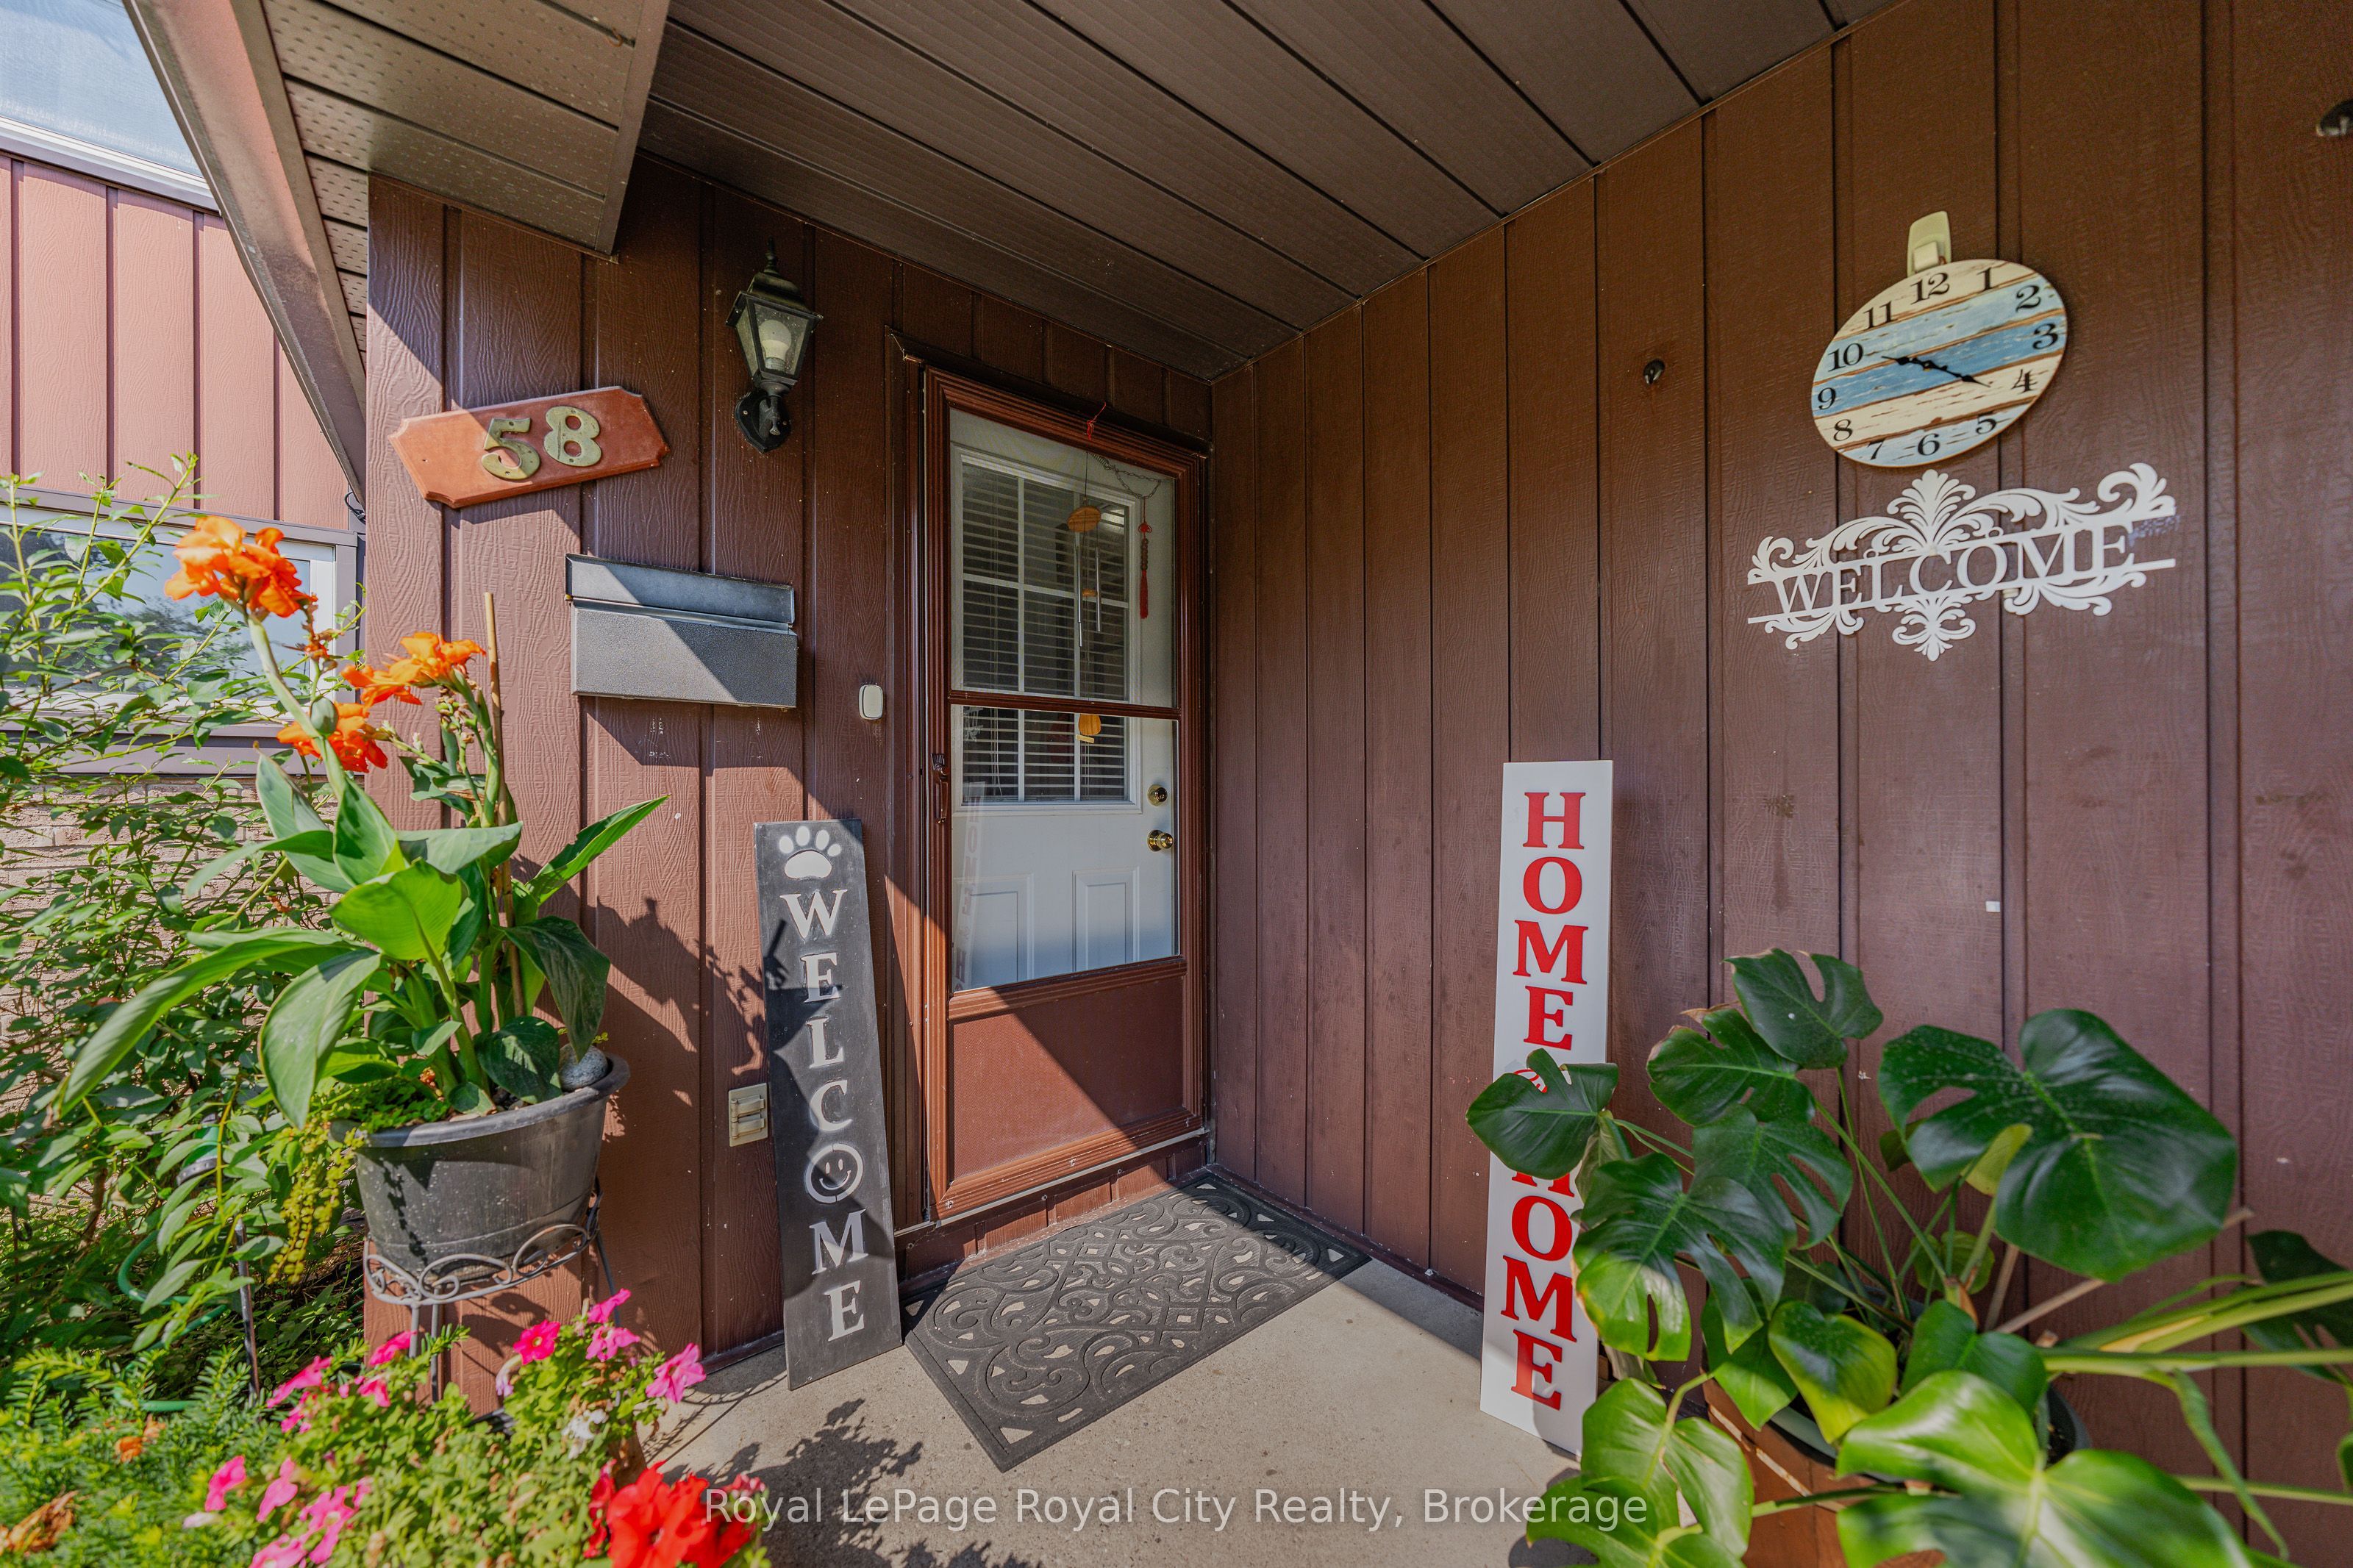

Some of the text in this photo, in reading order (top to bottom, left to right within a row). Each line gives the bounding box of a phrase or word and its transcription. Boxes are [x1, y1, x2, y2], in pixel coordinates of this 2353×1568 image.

[1910, 271, 1951, 305] 12
[1977, 267, 1998, 293] 1
[2015, 284, 2042, 314] 2
[1863, 302, 1899, 330] 11
[2032, 322, 2059, 351] 3
[1827, 342, 1864, 373] 10
[2010, 368, 2038, 393] 4
[1817, 387, 1837, 411] 9
[1833, 419, 1854, 442] 8
[1975, 412, 1998, 435] 5
[481, 405, 602, 481] 58
[1867, 439, 1887, 460] 7
[1917, 432, 1941, 457] 6
[1774, 520, 2135, 615] WELCOME
[1512, 791, 1590, 1051] HOME
[779, 888, 869, 1342] WELCOME
